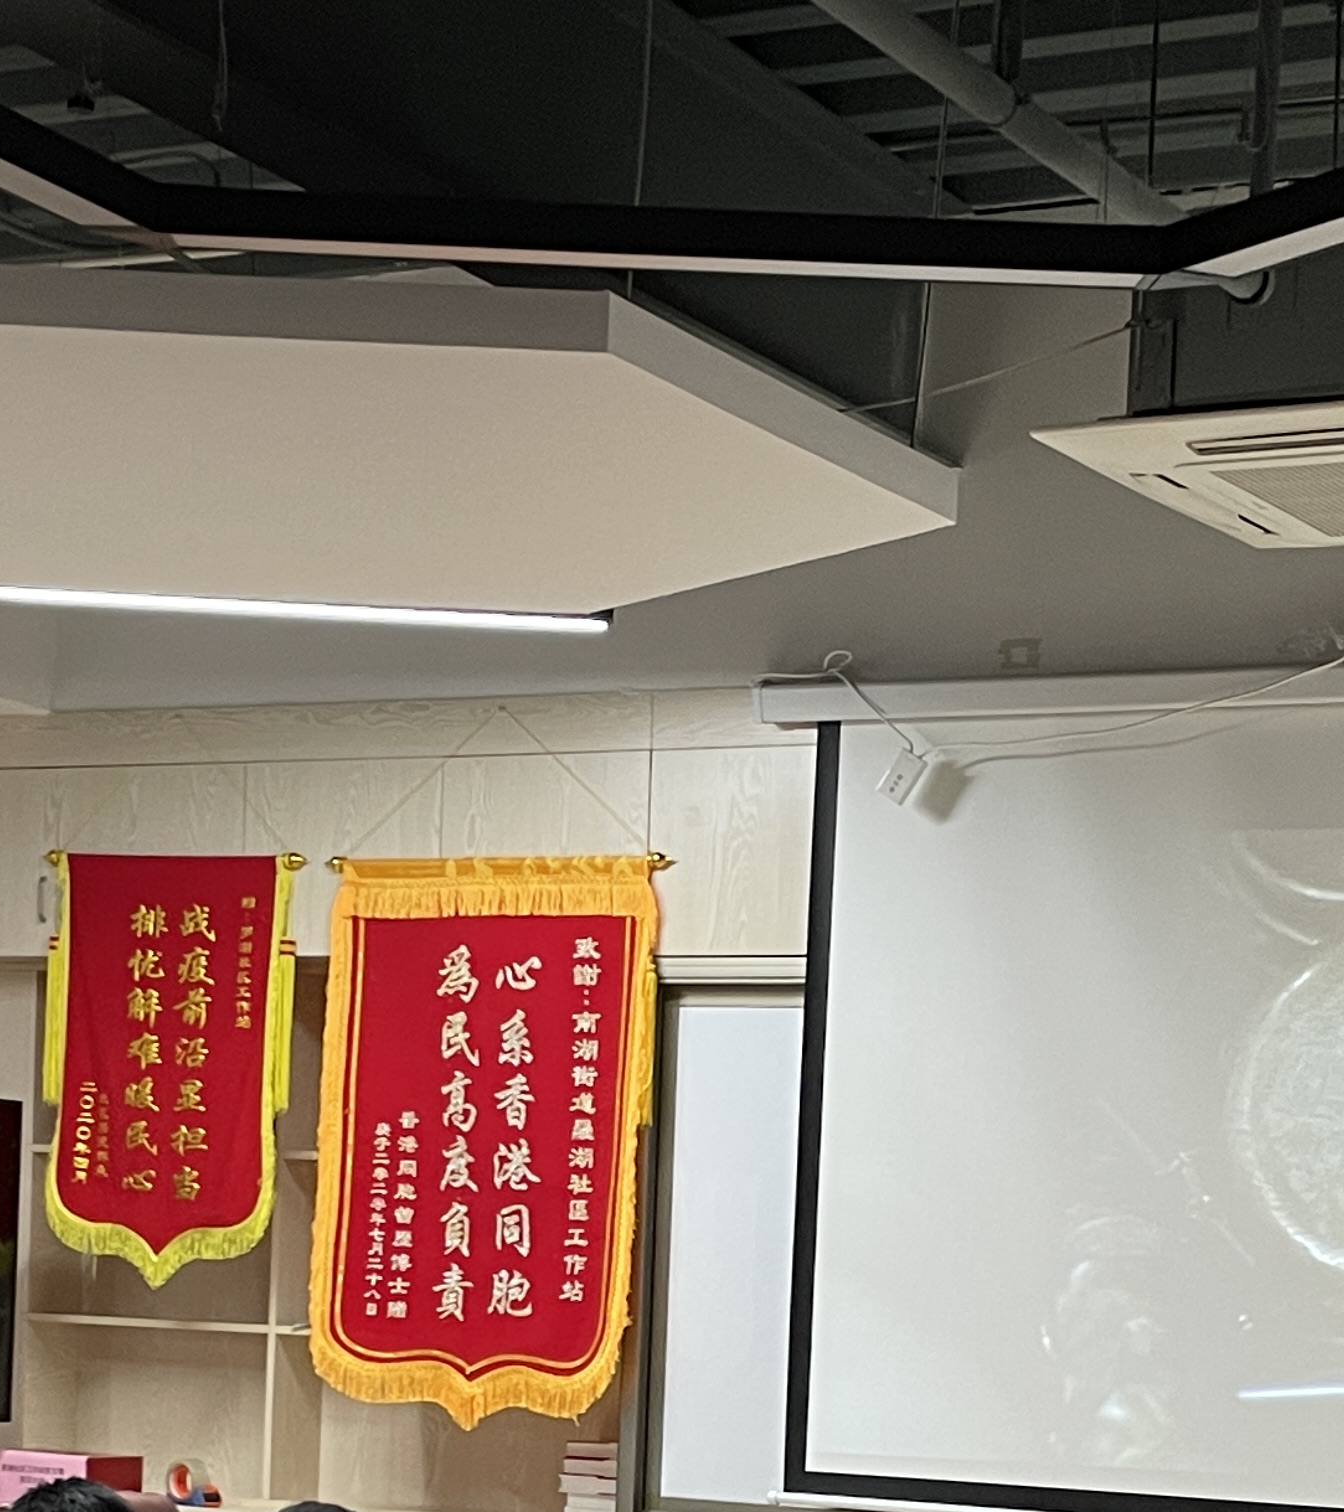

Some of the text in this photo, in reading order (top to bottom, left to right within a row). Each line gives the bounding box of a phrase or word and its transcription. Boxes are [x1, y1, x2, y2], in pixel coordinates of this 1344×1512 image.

[121, 903, 169, 1192] 排忧解难暖民心
[170, 903, 217, 1201] 战疫前沿显担当
[487, 955, 543, 1318] 心系香港同胞
